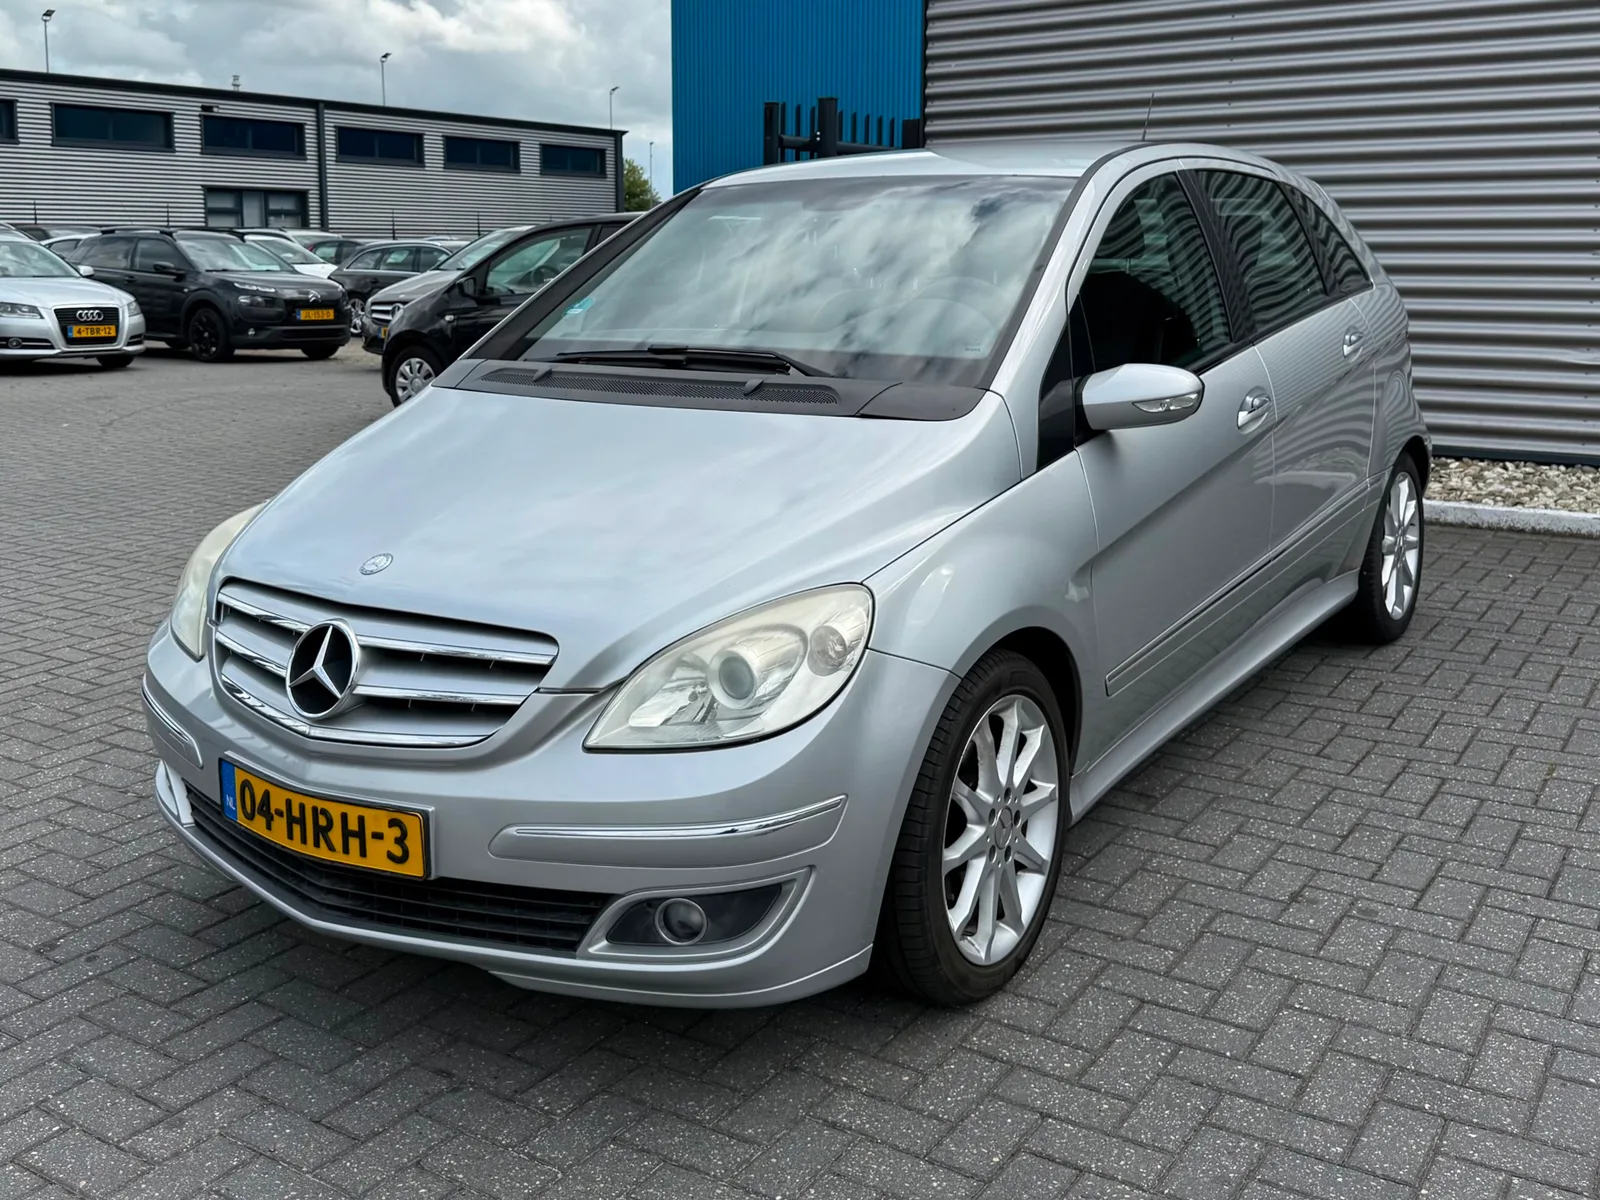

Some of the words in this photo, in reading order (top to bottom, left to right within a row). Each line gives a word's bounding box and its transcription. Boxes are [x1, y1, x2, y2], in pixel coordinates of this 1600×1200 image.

[76, 326, 112, 336] 4-TBR-12
[226, 794, 236, 810] NL
[239, 778, 410, 865] 04-HRH-3
